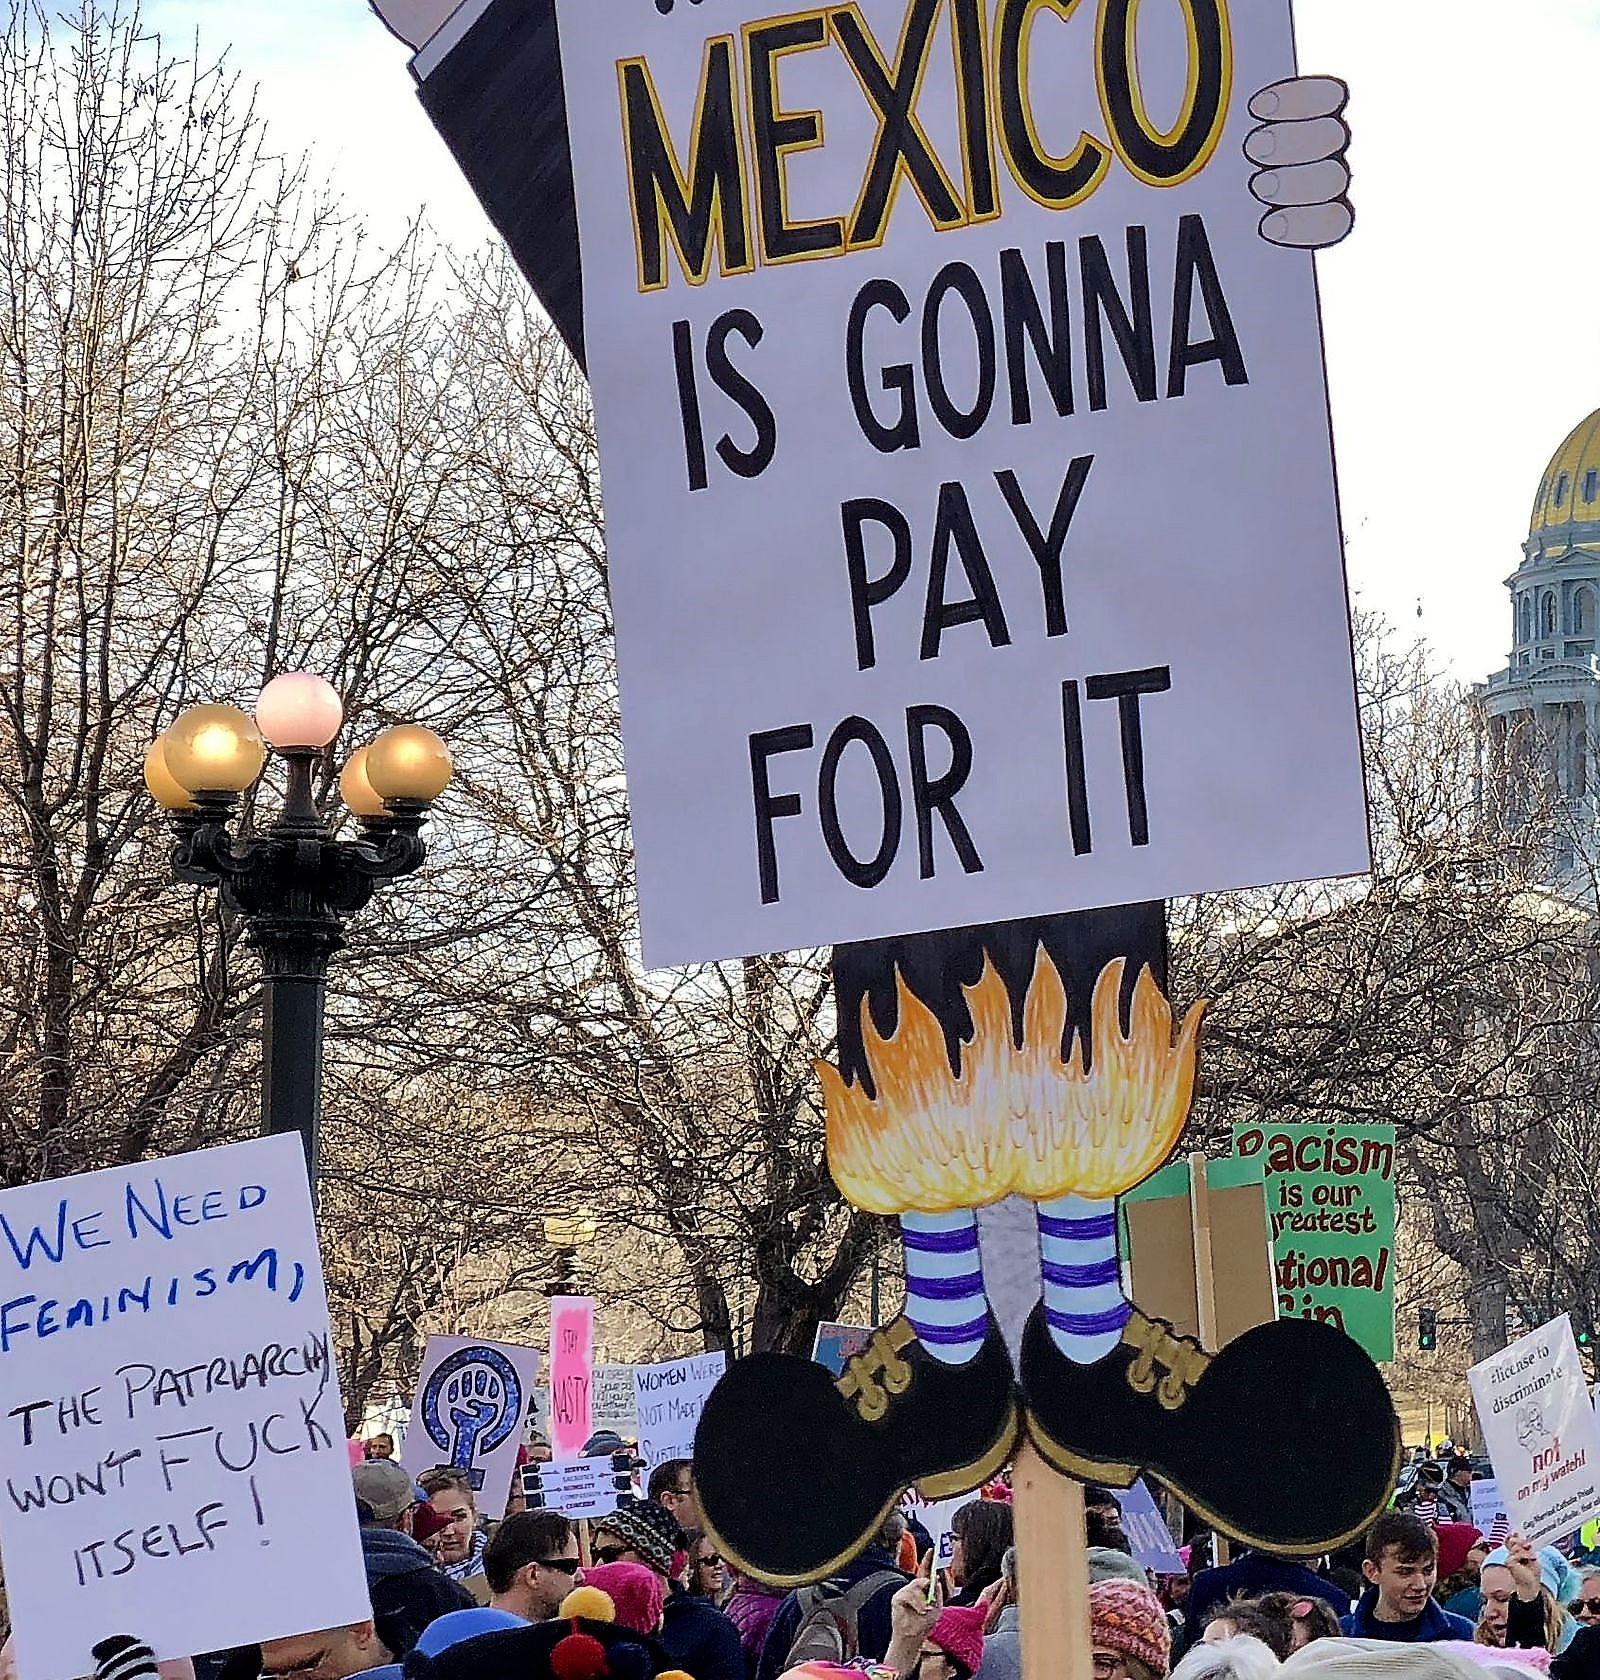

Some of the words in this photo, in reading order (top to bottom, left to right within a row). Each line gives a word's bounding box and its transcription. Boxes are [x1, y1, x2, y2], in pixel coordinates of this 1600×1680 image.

[615, 0, 1233, 292] MEXICO
[672, 307, 777, 491] IS
[846, 213, 1249, 454] GONNA
[841, 454, 1096, 671] PAY
[748, 704, 985, 905] FOR
[1061, 665, 1172, 857] IT
[1279, 1180, 1302, 1208] is
[1312, 1184, 1362, 1207] our
[0, 1199, 111, 1270] WE
[126, 1177, 267, 1240] NEED
[637, 1367, 686, 1391] WOMEN
[690, 1361, 723, 1381] WERE
[1537, 1345, 1549, 1359] to
[7, 1386, 102, 1447] THE
[638, 1403, 663, 1428] NOT
[1492, 1367, 1563, 1414] discriminate
[155, 1391, 333, 1492] FUCK
[1532, 1437, 1560, 1473] not
[1518, 1486, 1530, 1500] on
[1532, 1475, 1549, 1492] my
